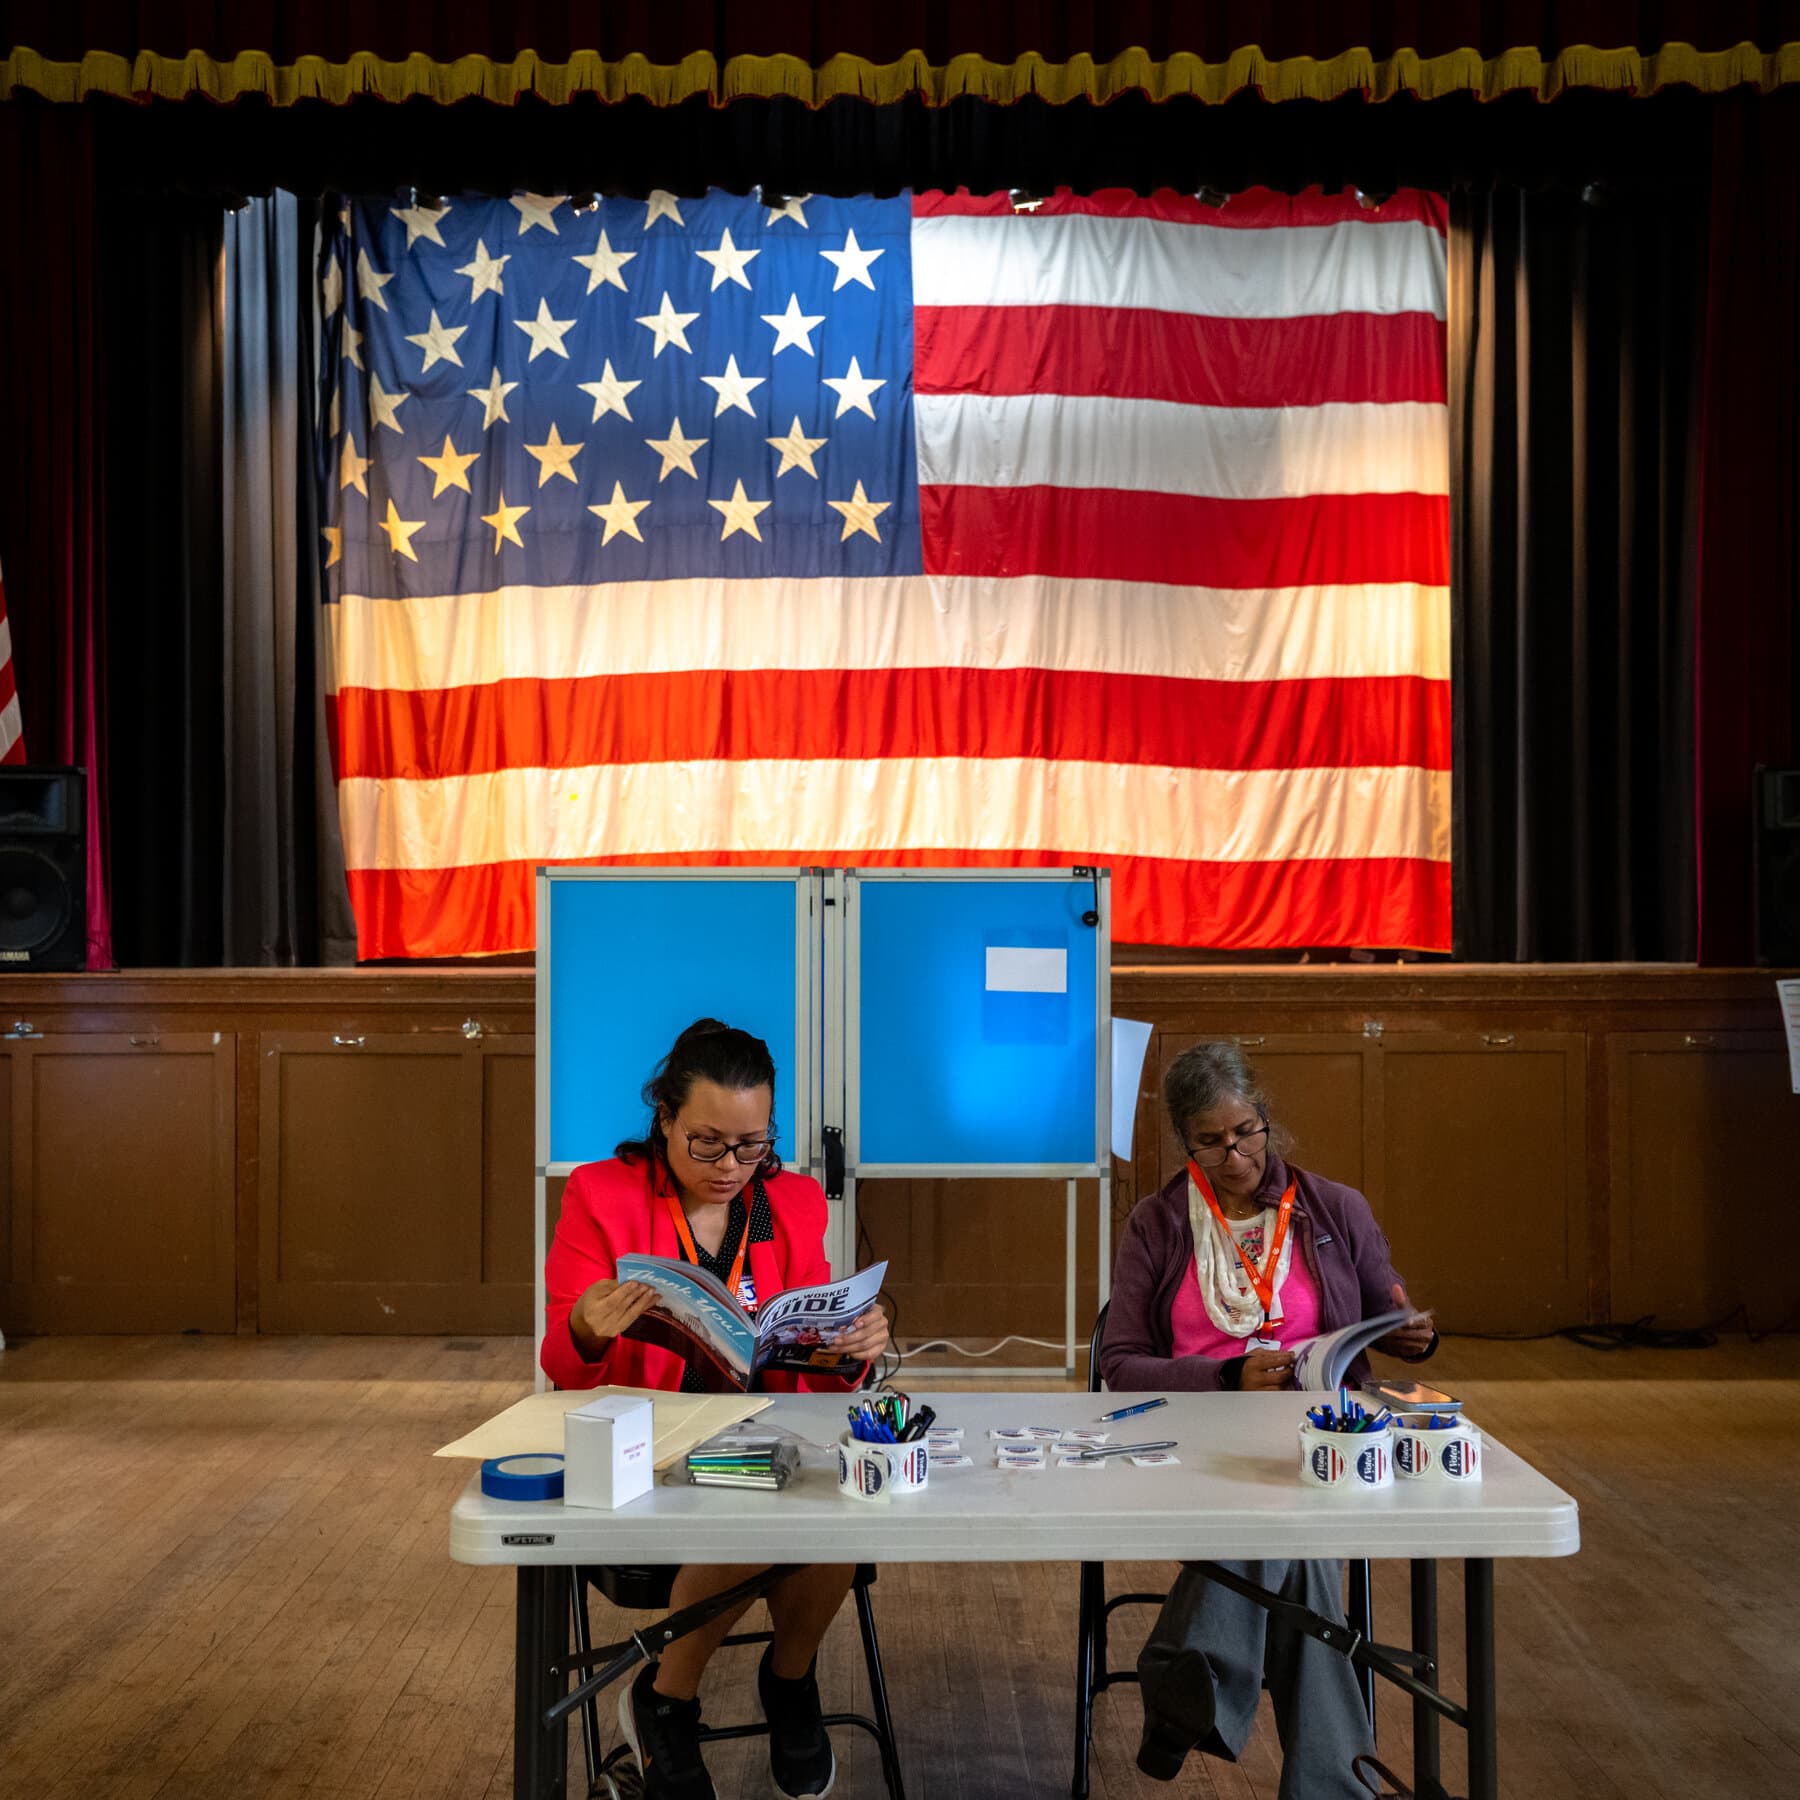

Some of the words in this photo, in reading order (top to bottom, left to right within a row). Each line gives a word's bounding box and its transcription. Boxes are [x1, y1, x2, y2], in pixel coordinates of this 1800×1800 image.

[627, 1269, 692, 1298] Thank
[697, 1297, 747, 1336] You!
[804, 1286, 850, 1299] WORKER
[770, 1293, 849, 1322] UIDE
[1363, 1451, 1373, 1475] Voted
[1401, 1440, 1409, 1463] Voted
[1448, 1444, 1458, 1468] Voted
